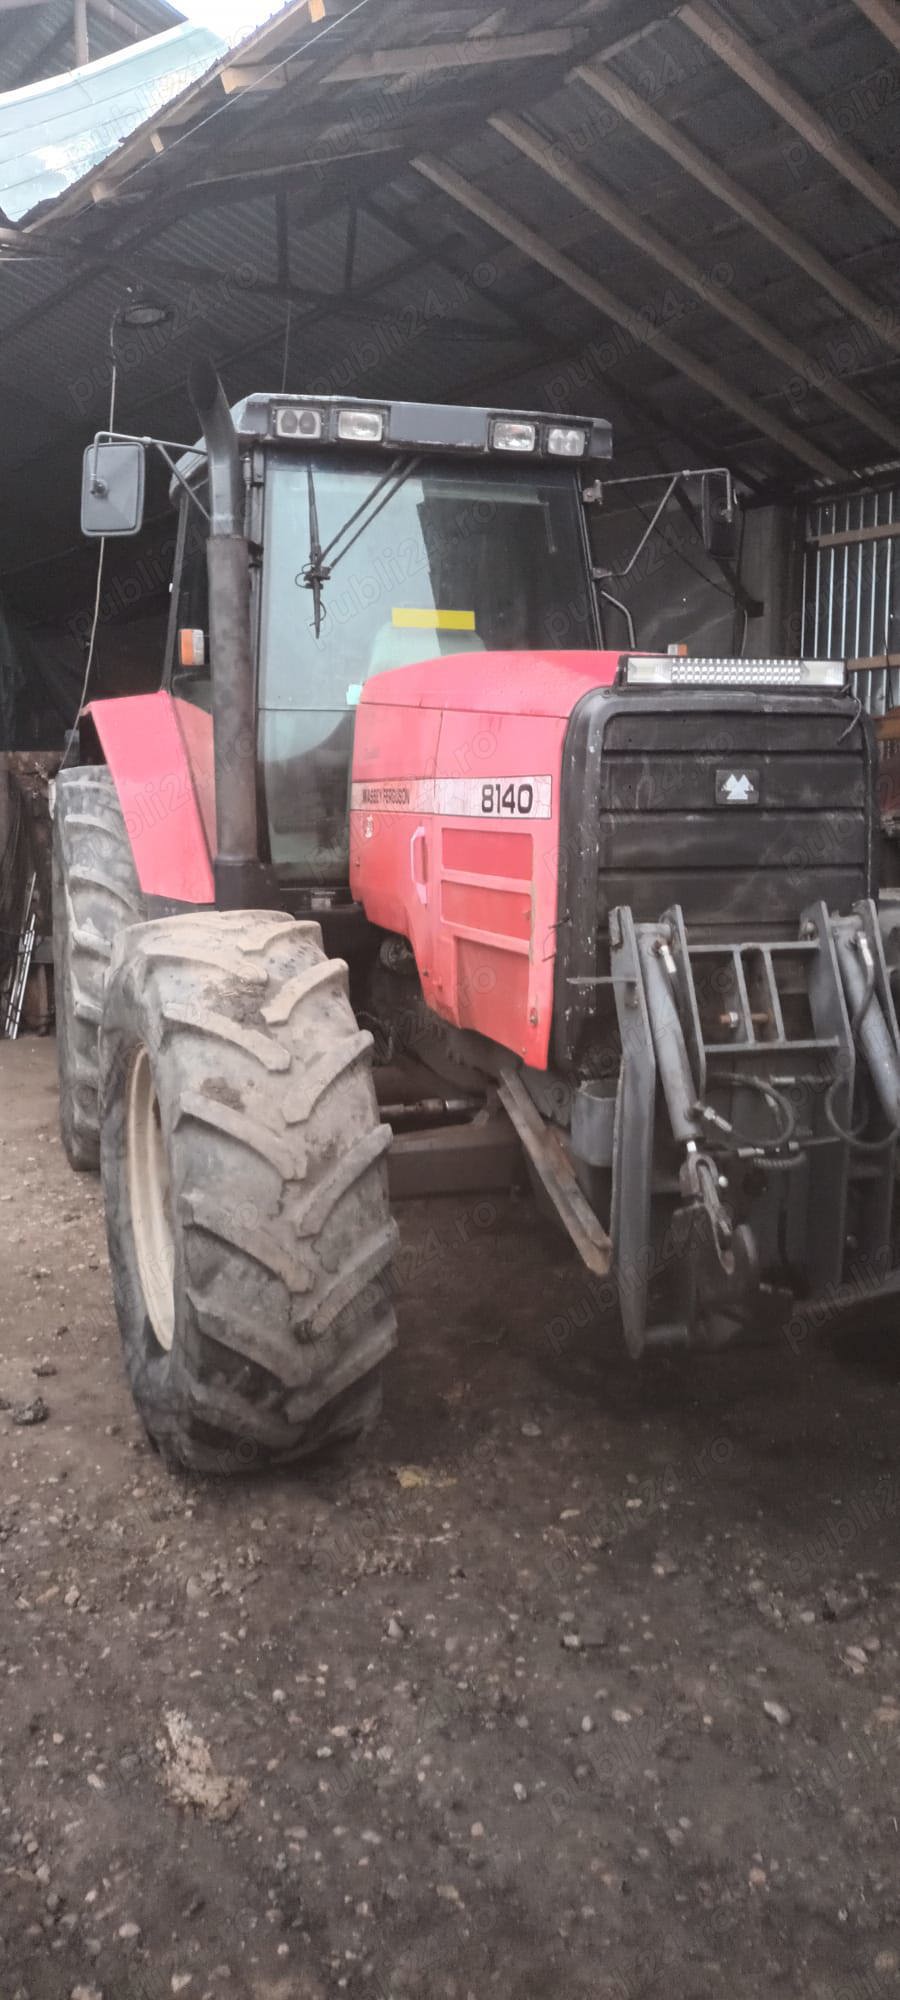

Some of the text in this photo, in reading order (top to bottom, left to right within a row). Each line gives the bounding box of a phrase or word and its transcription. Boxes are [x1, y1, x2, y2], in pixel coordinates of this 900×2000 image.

[362, 787, 410, 805] MASSEY FERGUSON
[481, 783, 534, 814] 8140
